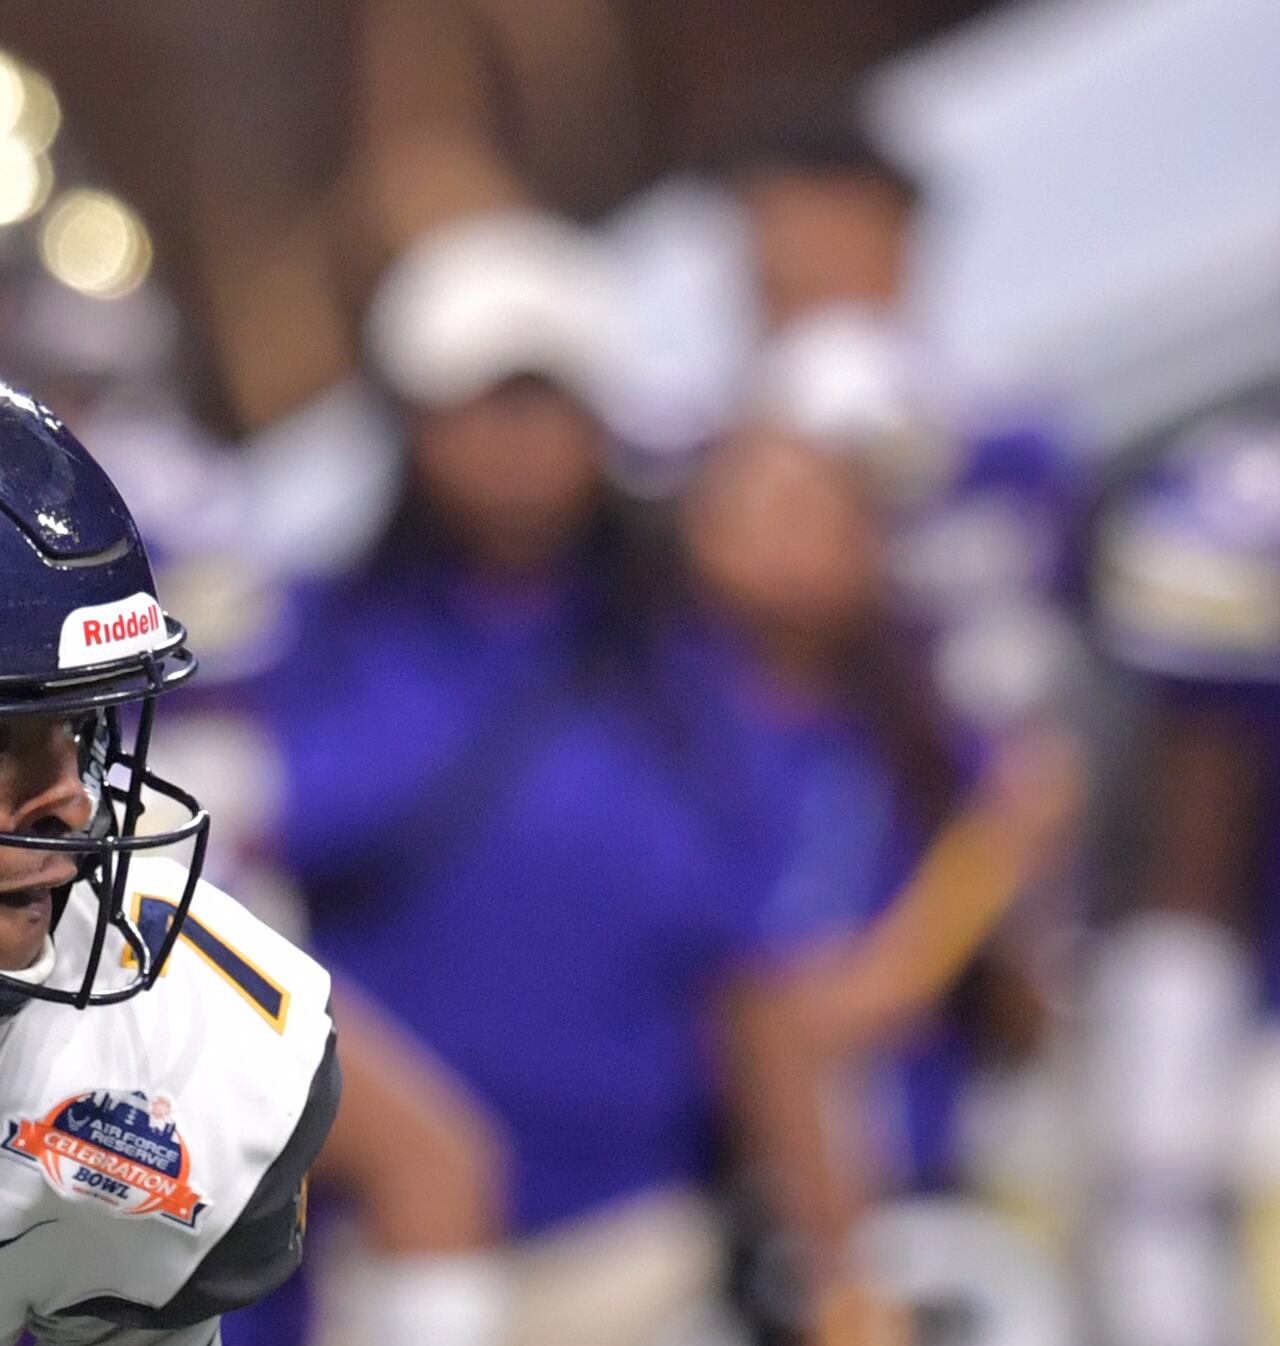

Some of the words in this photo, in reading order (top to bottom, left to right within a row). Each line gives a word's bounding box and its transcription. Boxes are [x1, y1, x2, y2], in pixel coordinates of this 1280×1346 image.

[82, 604, 159, 647] Riddell
[89, 1119, 122, 1138] AIR
[121, 1131, 180, 1164] FORCE
[90, 1130, 170, 1170] RESERVE
[43, 1131, 177, 1196] CELEBRATION
[72, 1167, 129, 1199] BOWL
